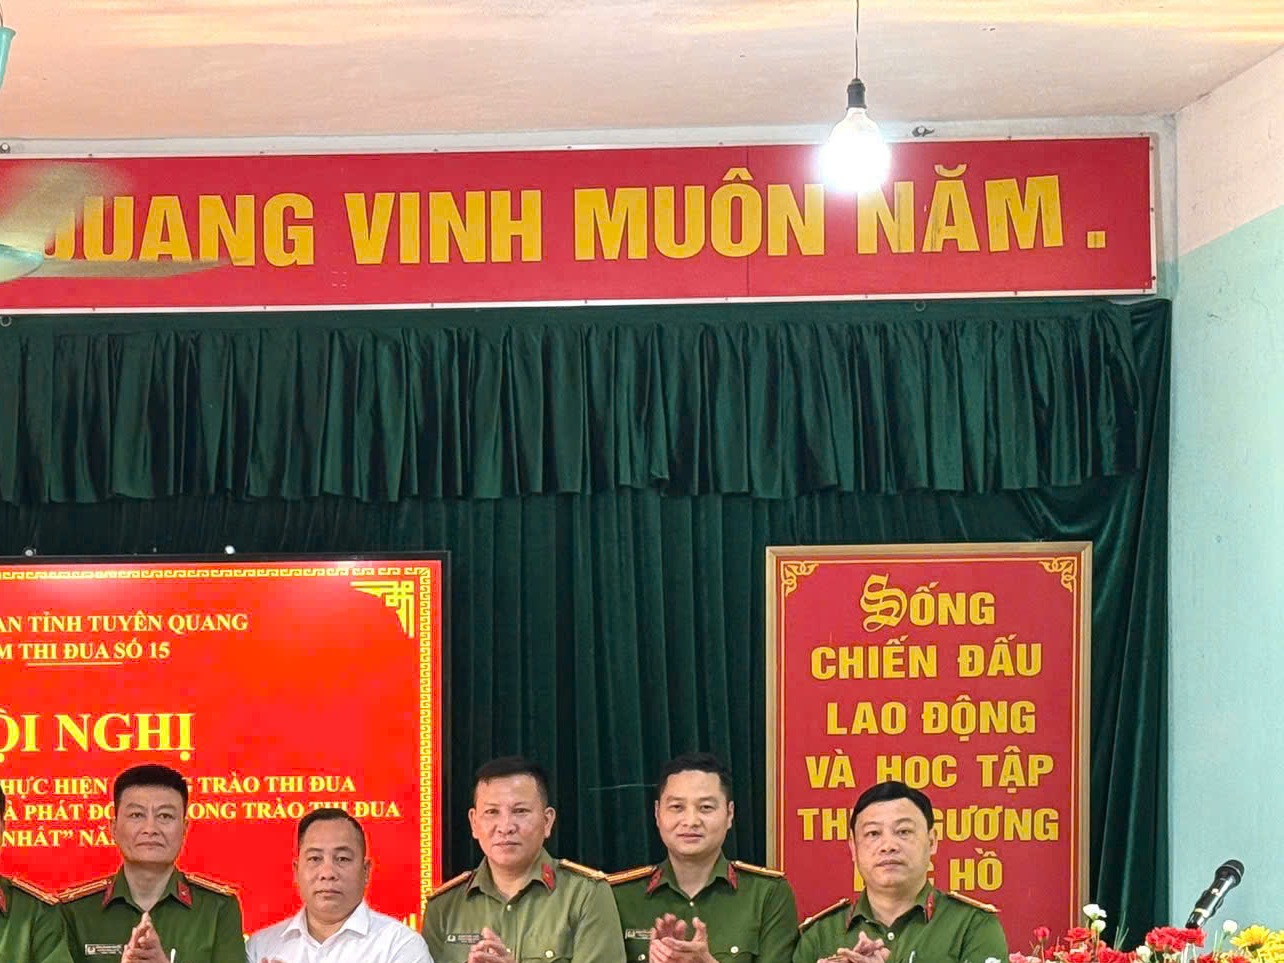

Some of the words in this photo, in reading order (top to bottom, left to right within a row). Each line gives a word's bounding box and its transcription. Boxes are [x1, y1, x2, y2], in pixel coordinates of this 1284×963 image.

[44, 191, 315, 268] UANG
[345, 190, 554, 264] VINH
[574, 167, 826, 261] MUÔN
[857, 163, 1064, 255] NĂM
[28, 610, 83, 632] TỈNH
[87, 610, 163, 632] TUYÊN
[168, 613, 249, 634] QUANG
[860, 573, 995, 632] SỐNG
[18, 642, 58, 660] THI
[63, 641, 110, 660] ĐUA
[113, 637, 143, 659] SỐ
[150, 641, 171, 659] 15
[811, 635, 937, 680] CHIẾN
[957, 633, 1042, 678] ĐẤU
[54, 712, 196, 762] NGHỊ
[827, 702, 907, 735] LAO
[921, 694, 1036, 742] ĐỘNG
[53, 776, 108, 799] HIỆN
[198, 771, 260, 793] TRÀO
[264, 776, 304, 793] THI
[309, 775, 357, 793] ĐUA
[805, 749, 856, 789] VÀ
[976, 745, 1054, 794] TẬP
[25, 800, 84, 821] PHÁT
[187, 802, 237, 820] ONG
[242, 797, 305, 819] TRÀO
[354, 801, 401, 818] ĐUA
[797, 808, 854, 841] TH
[79, 825, 116, 848] NĂ
[949, 847, 1004, 892] HỒ
